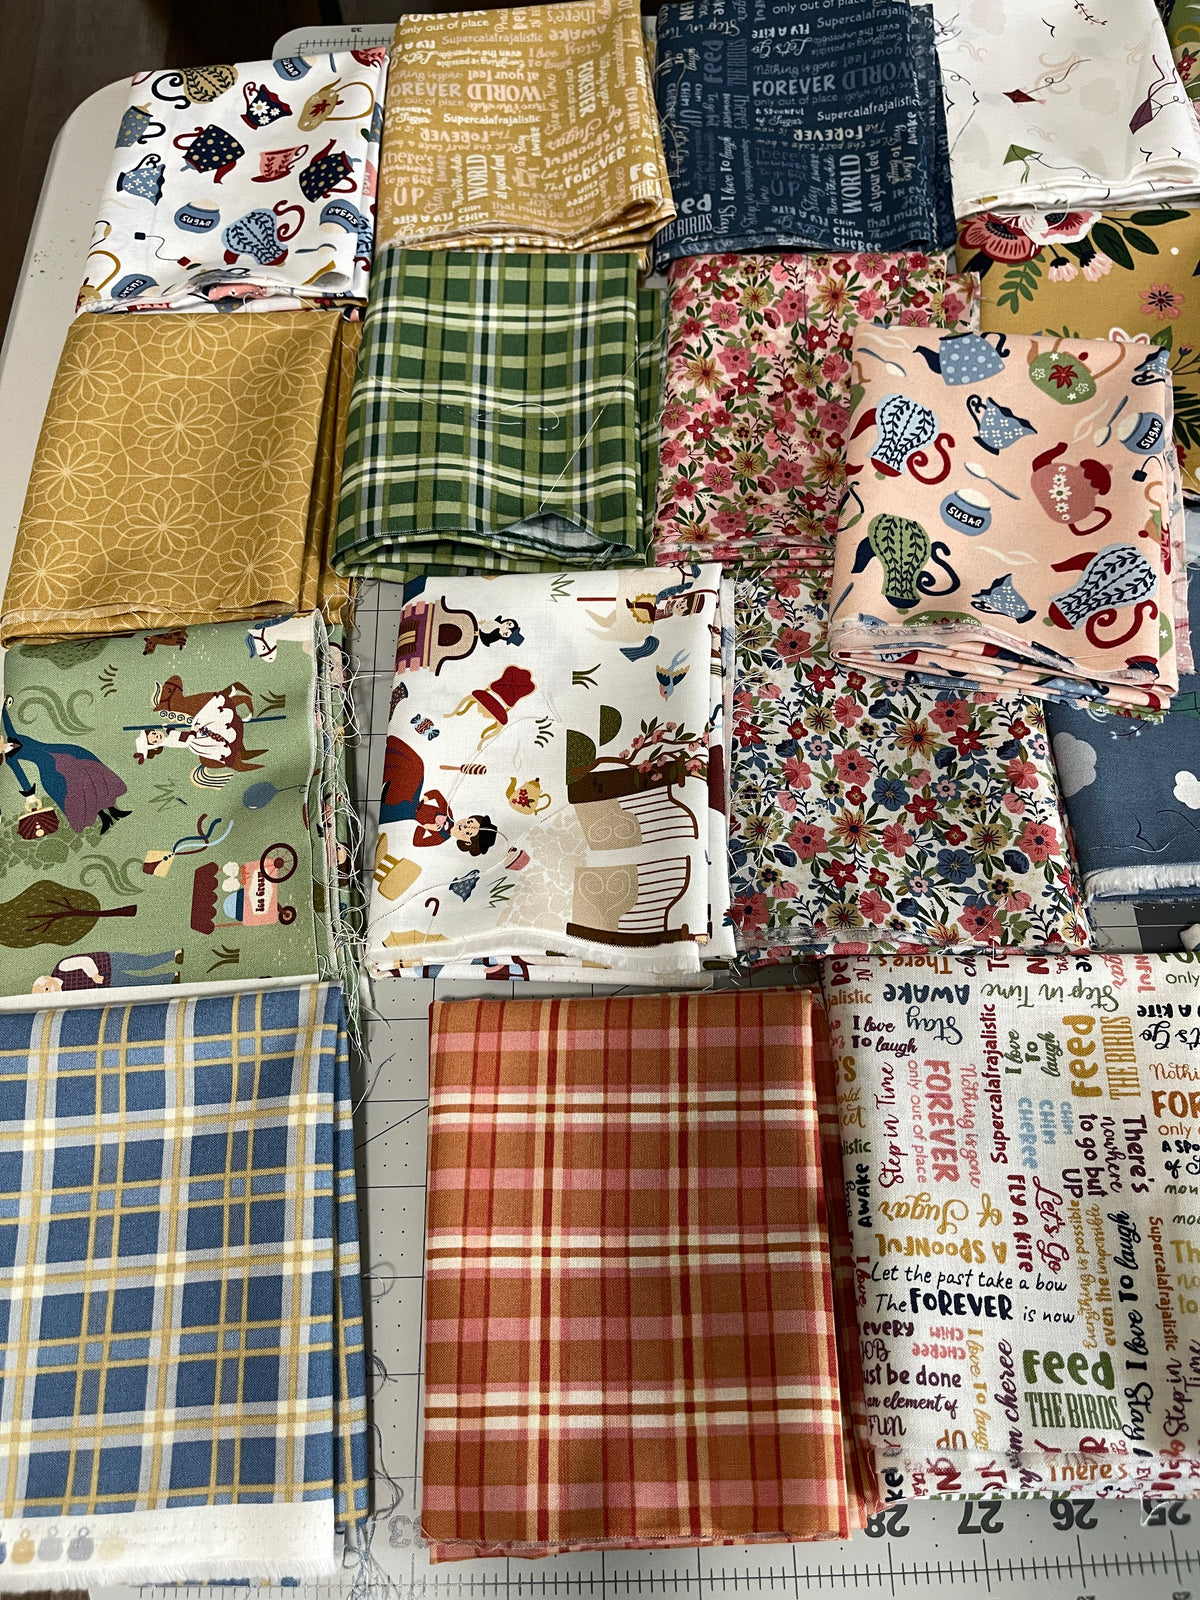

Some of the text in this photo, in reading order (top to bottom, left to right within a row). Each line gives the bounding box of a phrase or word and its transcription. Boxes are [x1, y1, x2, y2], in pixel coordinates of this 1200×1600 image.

[772, 1, 820, 17] only out
[467, 83, 541, 103] WORLD
[752, 74, 837, 98] FOREVER
[842, 61, 914, 91] WORLD
[443, 113, 541, 128] Supercalafrajalistic
[817, 96, 914, 123] Supercalafrajalistic
[420, 127, 489, 143] FOREVER
[793, 125, 863, 142] FOREVER
[466, 153, 489, 202] WORLD
[564, 146, 626, 190] FOREVER
[839, 153, 864, 215] WORLD
[180, 214, 213, 229] SUGAR
[677, 212, 714, 242] BIRDS
[1139, 420, 1164, 450] SUGAR
[945, 504, 984, 531] SUGAR
[878, 955, 953, 976] There's
[1165, 971, 1200, 988] only
[980, 977, 1120, 1013] Step in Time
[853, 1015, 896, 1033] I love
[905, 1005, 964, 1046] Stay
[1099, 1016, 1138, 1064] BIRDS
[1138, 1020, 1172, 1055] Go
[874, 1035, 919, 1059] laugh
[1003, 1028, 1025, 1075] I love
[1037, 1031, 1064, 1078] laugh
[1062, 1014, 1104, 1099] Feed
[980, 1003, 1011, 1165] Supercalafrajalistic
[1105, 1065, 1142, 1101] THE
[873, 1061, 909, 1188] Step in Time
[906, 1059, 930, 1184] only out of place
[923, 1059, 961, 1183] FOREVER
[1074, 1113, 1109, 1198] to go but
[1099, 1116, 1127, 1195] nowhere
[1122, 1113, 1156, 1195] There's
[1161, 1139, 1174, 1153] A
[958, 1147, 982, 1189] gone
[1061, 1167, 1085, 1199] UP
[1163, 1158, 1184, 1180] of
[877, 1191, 970, 1236] Sugar
[975, 1192, 1003, 1229] of
[1012, 1211, 1030, 1226] A
[1032, 1175, 1071, 1276] Let's Go
[874, 1233, 1008, 1265] A SPOONFUL
[1106, 1210, 1142, 1271] laugh
[871, 1261, 1068, 1292] Let the past take a bow
[1147, 1215, 1180, 1354] Supercalafrajalistic
[875, 1287, 1075, 1324] The FOREVER is now
[967, 1328, 984, 1338] I
[1101, 1304, 1118, 1347] even
[1123, 1309, 1150, 1356] love
[886, 1363, 962, 1388] be done
[966, 1339, 985, 1378] love
[1022, 1349, 1116, 1391] Feed
[1125, 1359, 1148, 1371] I
[883, 1390, 960, 1420] element of
[1024, 1391, 1123, 1431] THE BIRDS
[1121, 1381, 1155, 1443] Stay
[1162, 1357, 1193, 1438] Step in
[864, 1502, 910, 1539] 28
[957, 1500, 1004, 1536] 27
[1049, 1498, 1098, 1532] 26
